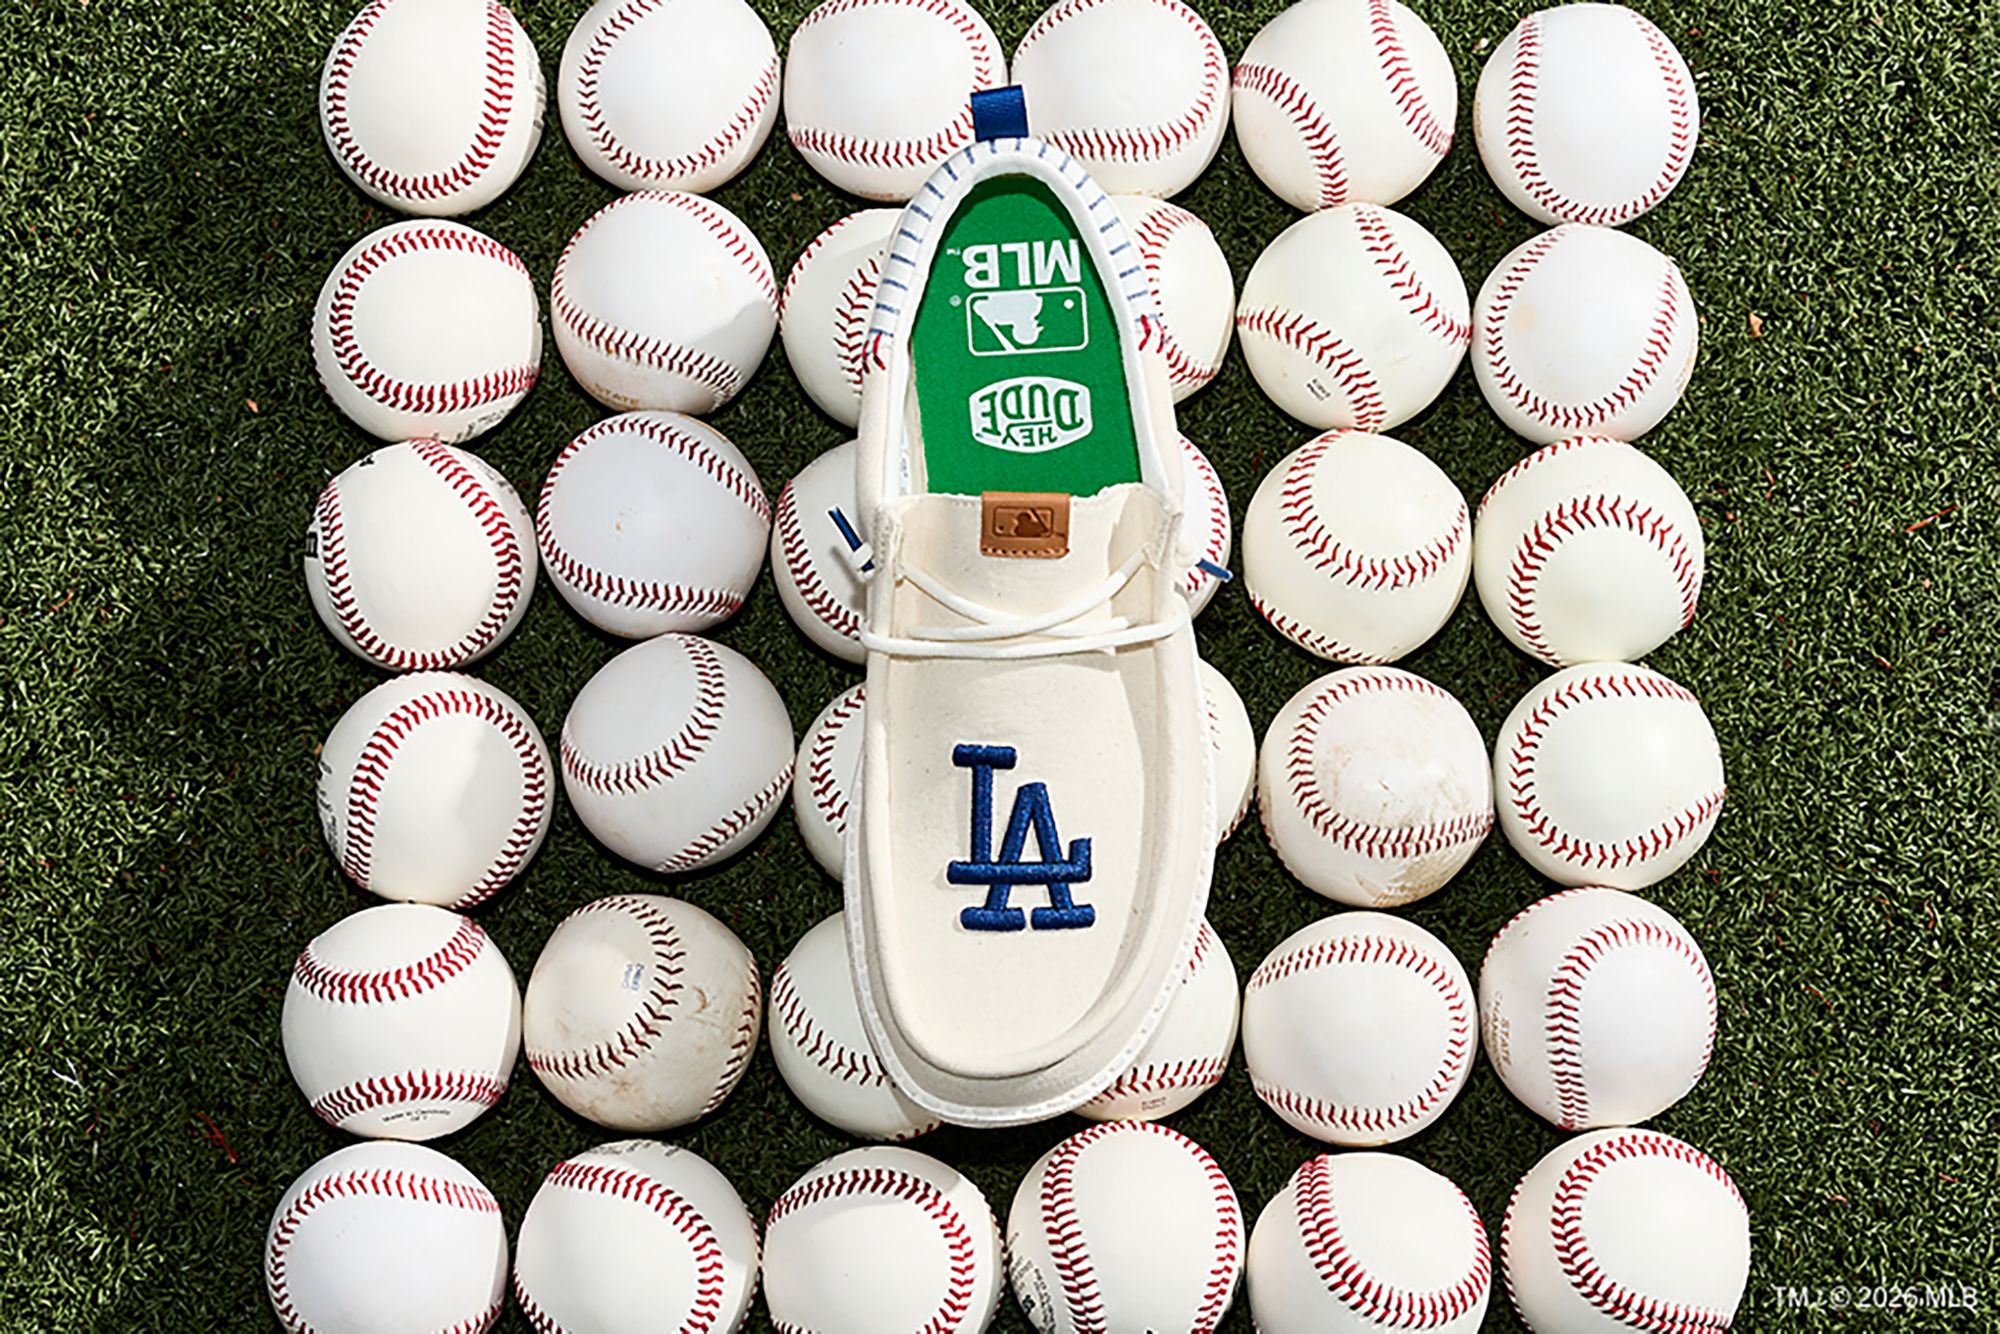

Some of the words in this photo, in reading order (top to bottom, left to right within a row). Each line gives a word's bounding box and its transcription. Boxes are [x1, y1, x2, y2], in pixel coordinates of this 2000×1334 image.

[962, 239, 1081, 287] MLB
[979, 384, 1084, 436] DUDE
[1002, 421, 1058, 447] HEY
[947, 743, 1095, 931] LA
